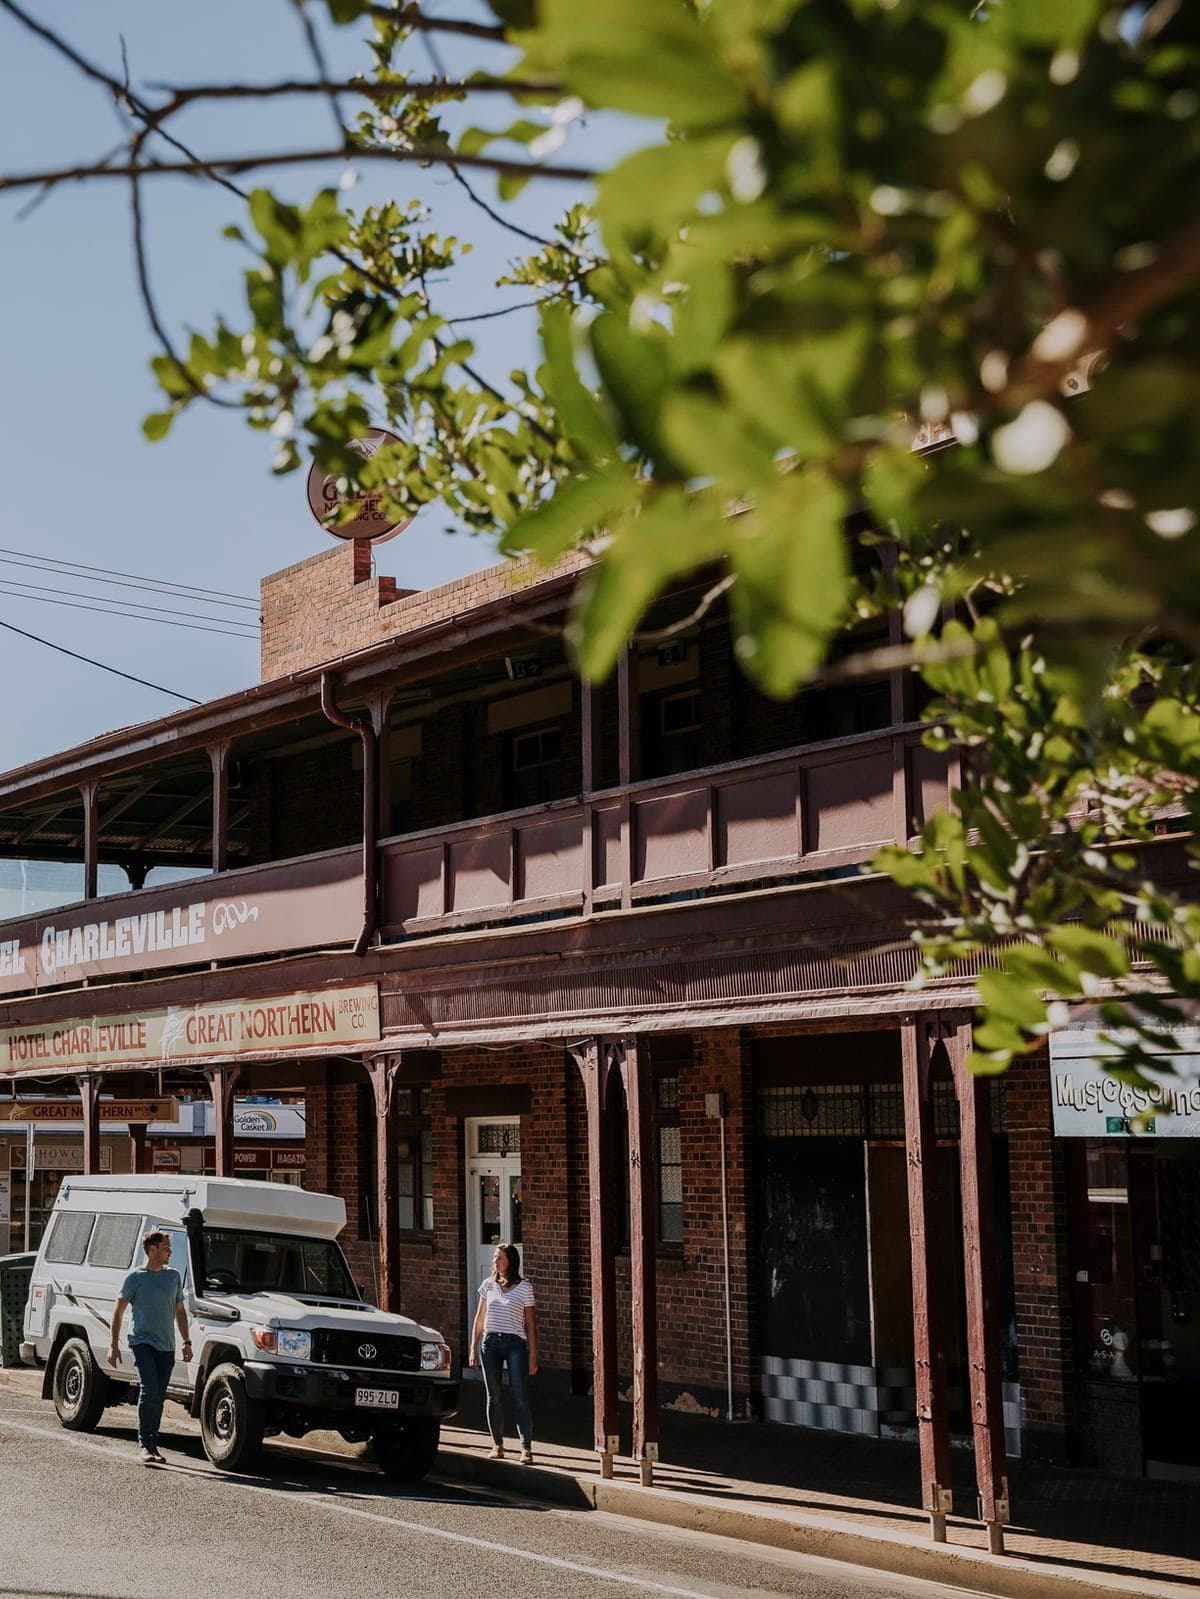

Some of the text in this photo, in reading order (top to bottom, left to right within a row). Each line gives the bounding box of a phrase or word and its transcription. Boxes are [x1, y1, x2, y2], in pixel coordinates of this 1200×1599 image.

[41, 902, 205, 976] CHARLEVILLE
[338, 995, 378, 1015] BREWING
[186, 1001, 337, 1045] GREAT NORTHERN
[8, 1021, 147, 1061] HOTEL CHARLEVILLE
[32, 1106, 69, 1118] GREAT
[234, 1114, 261, 1124] Golden
[240, 1123, 266, 1132] Casket
[234, 1153, 257, 1163] POWER
[357, 1390, 375, 1403] 995
